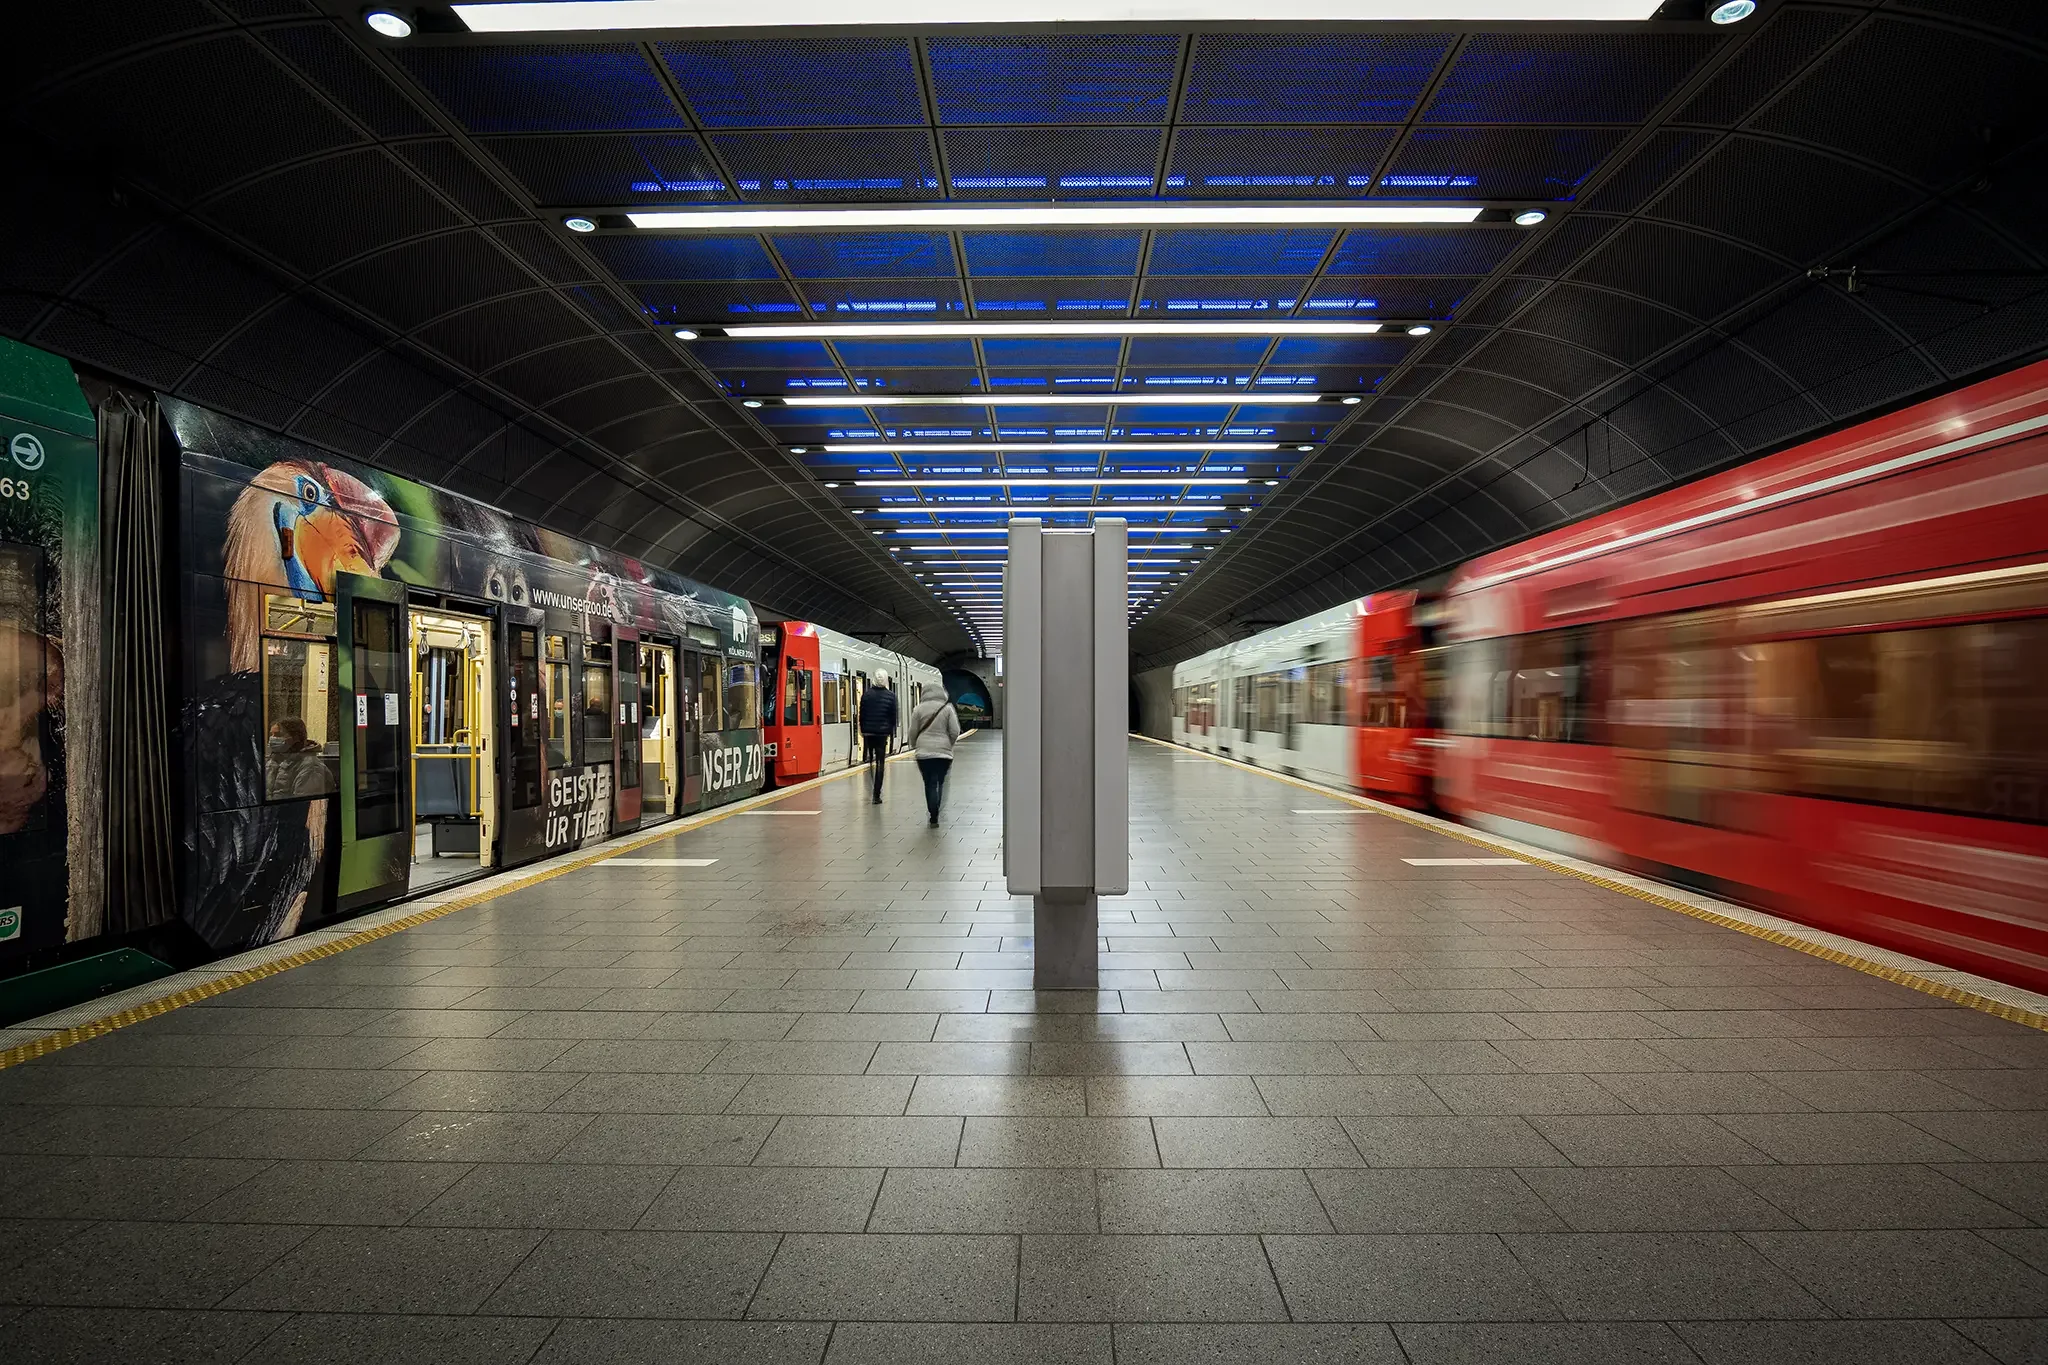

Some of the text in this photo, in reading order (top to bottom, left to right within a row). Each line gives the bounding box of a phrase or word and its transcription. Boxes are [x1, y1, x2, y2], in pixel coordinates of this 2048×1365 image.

[0, 477, 30, 501] 63
[532, 588, 612, 618] www.unserzoo.de
[745, 650, 754, 659] ZOO
[745, 743, 763, 783] ZO
